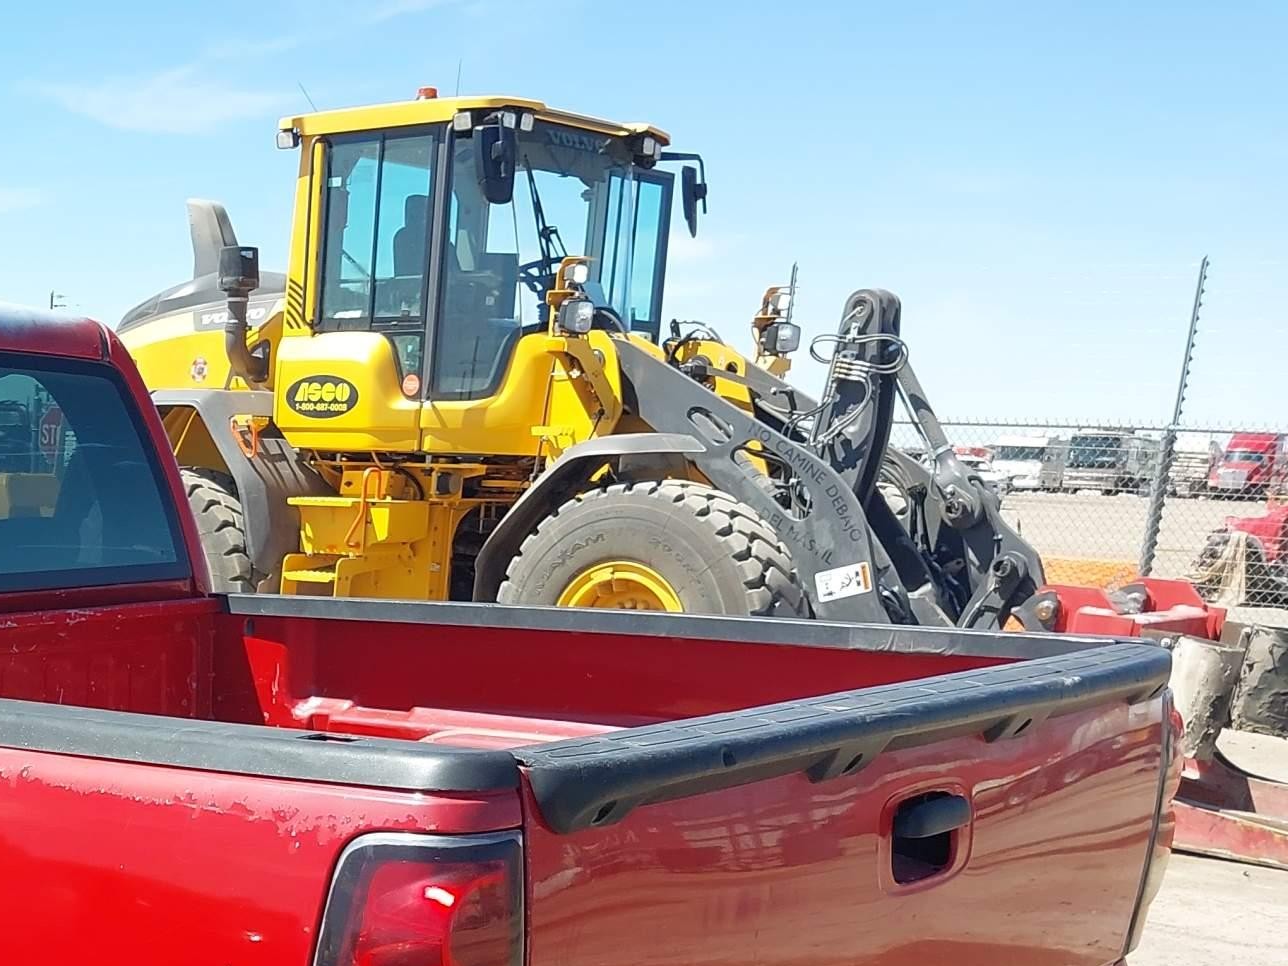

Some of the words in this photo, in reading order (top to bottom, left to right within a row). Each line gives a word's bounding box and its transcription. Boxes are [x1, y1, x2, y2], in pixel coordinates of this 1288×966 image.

[201, 307, 266, 325] VOO
[294, 382, 350, 402] ASCO
[775, 439, 827, 485] CAMINE
[825, 484, 862, 542] DEBAJO
